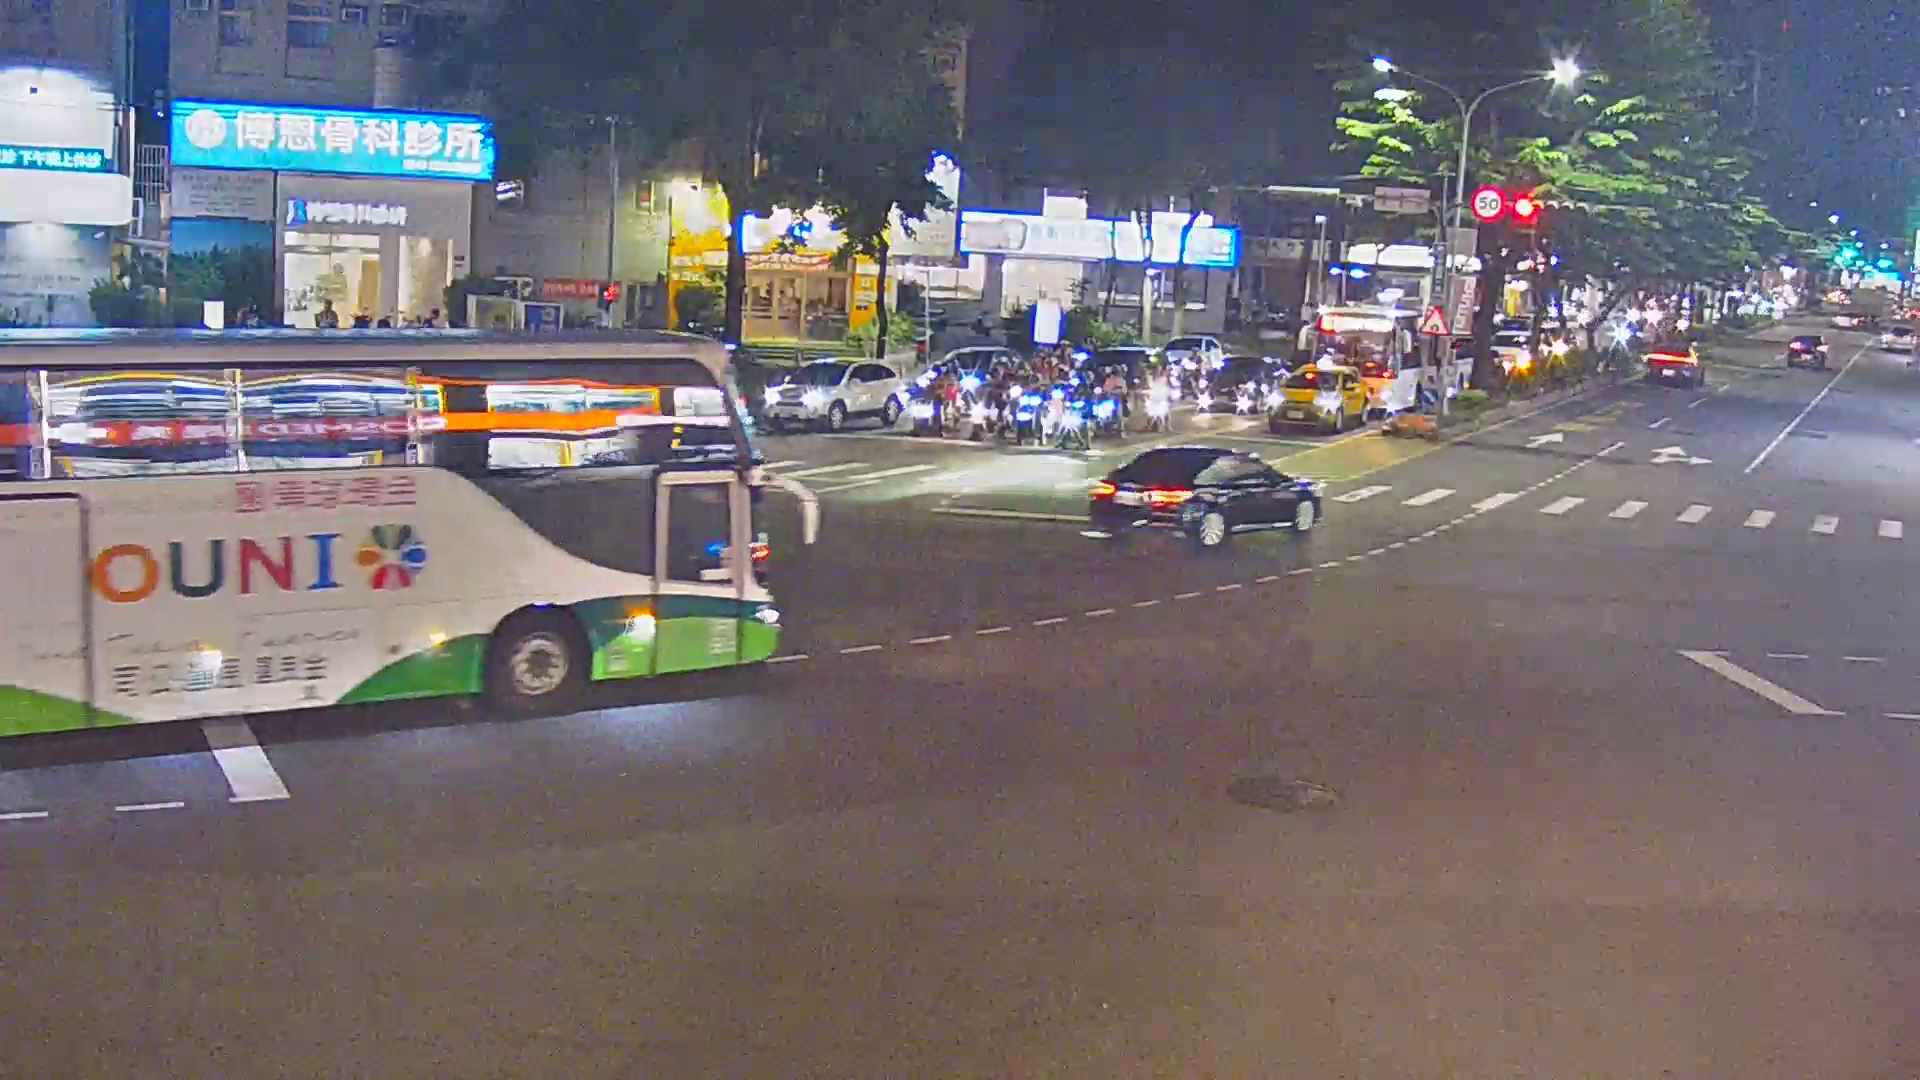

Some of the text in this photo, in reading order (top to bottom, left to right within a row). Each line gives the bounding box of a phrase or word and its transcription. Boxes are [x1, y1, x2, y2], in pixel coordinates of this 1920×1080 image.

[235, 110, 484, 160] 博恩骨科診所
[1479, 197, 1499, 211] 50
[91, 533, 343, 603] OUNI
